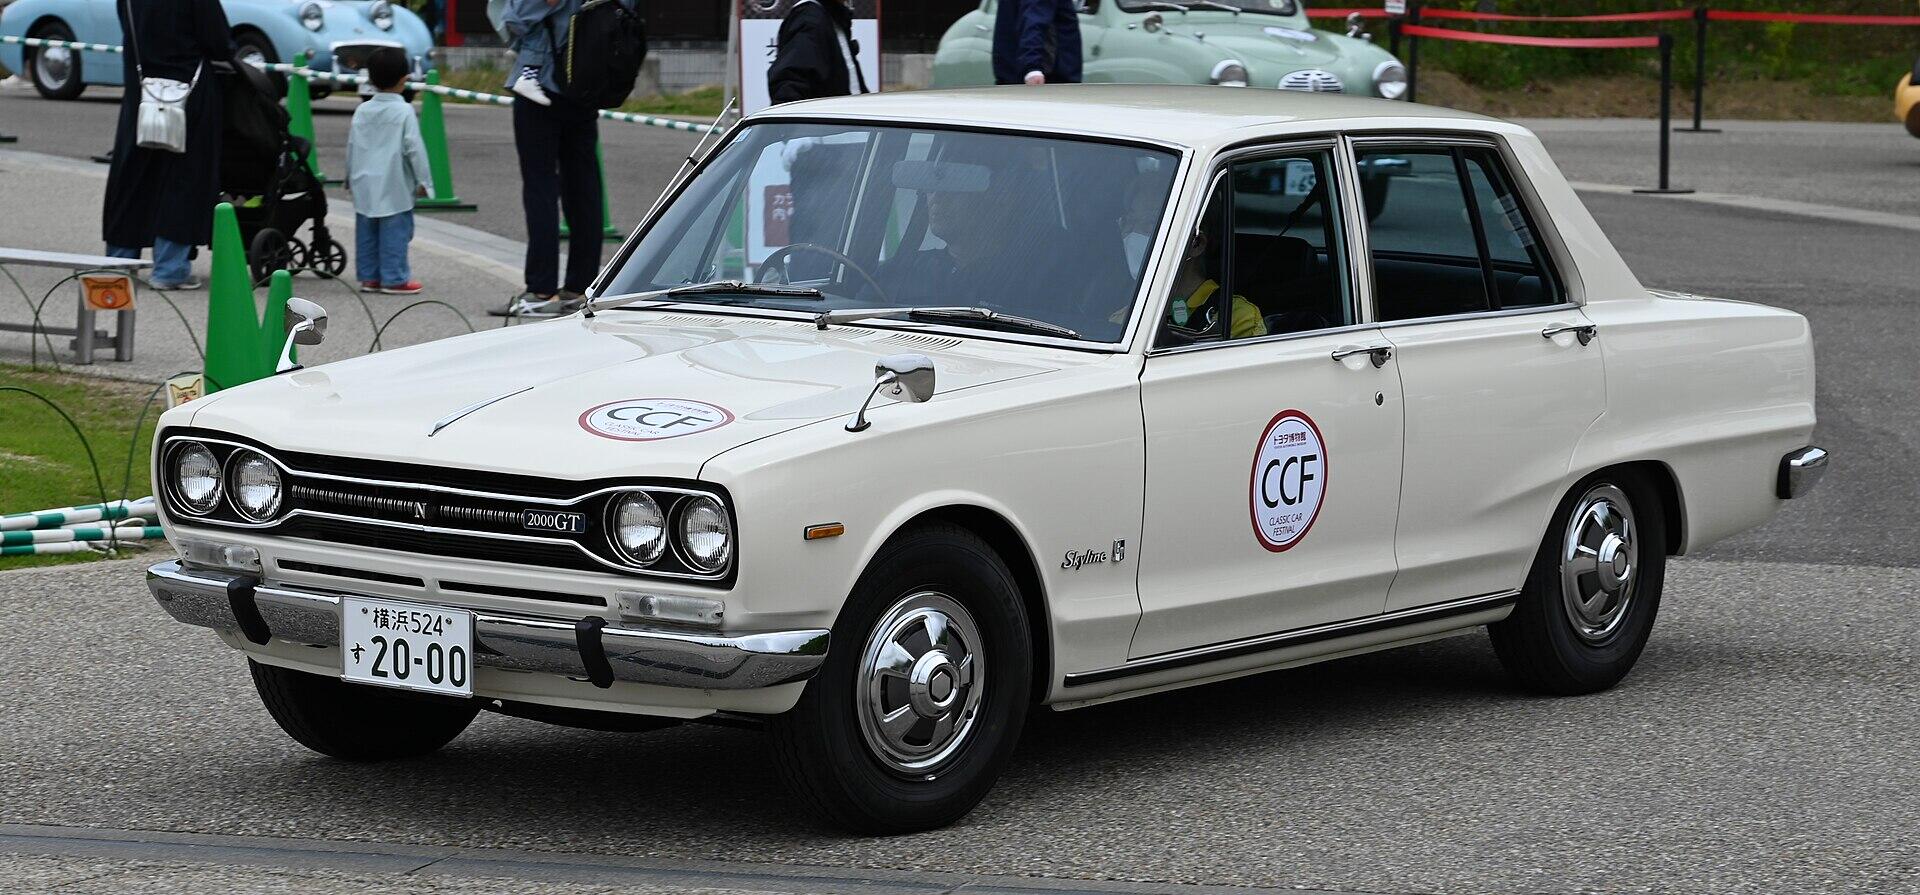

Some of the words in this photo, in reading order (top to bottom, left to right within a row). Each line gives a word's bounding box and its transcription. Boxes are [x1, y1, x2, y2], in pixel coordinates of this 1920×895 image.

[607, 406, 713, 428] CCF
[1274, 432, 1306, 445] トヨタ博物館
[1262, 454, 1317, 508] CCF
[414, 502, 427, 519] N
[1269, 514, 1291, 526] CLASSIC
[1291, 513, 1303, 523] CAR
[527, 513, 581, 531] 2000GT
[1273, 525, 1295, 537] FESTIVAL
[1061, 549, 1107, 570] Skyline
[350, 642, 366, 665] す
[370, 635, 466, 688] 20-00
